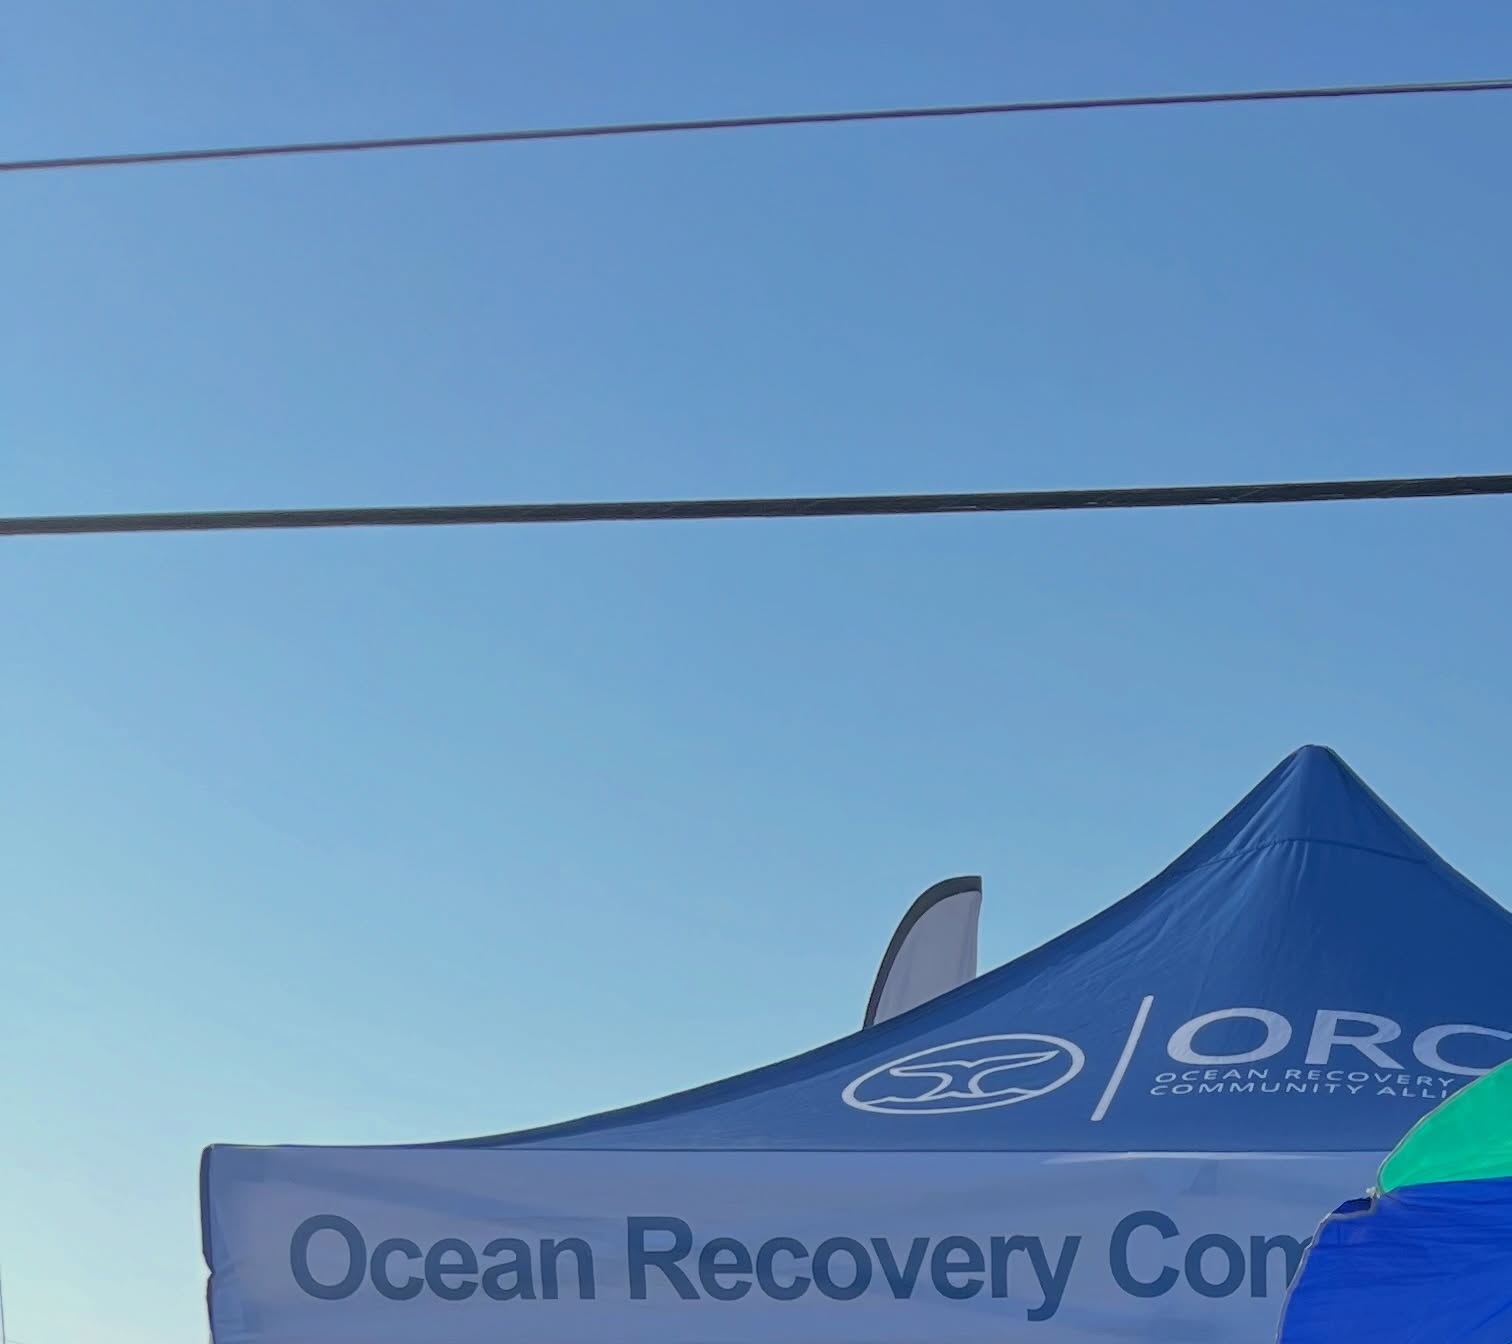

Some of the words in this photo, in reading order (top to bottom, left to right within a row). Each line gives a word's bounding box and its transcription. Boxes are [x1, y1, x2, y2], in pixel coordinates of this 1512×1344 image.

[1155, 1068, 1268, 1083] OCEAN
[1285, 1069, 1455, 1086] RECOVERY
[1150, 1082, 1368, 1097] COMMUNITY
[289, 1213, 596, 1302] Ocean
[627, 1215, 1082, 1322] Recovery
